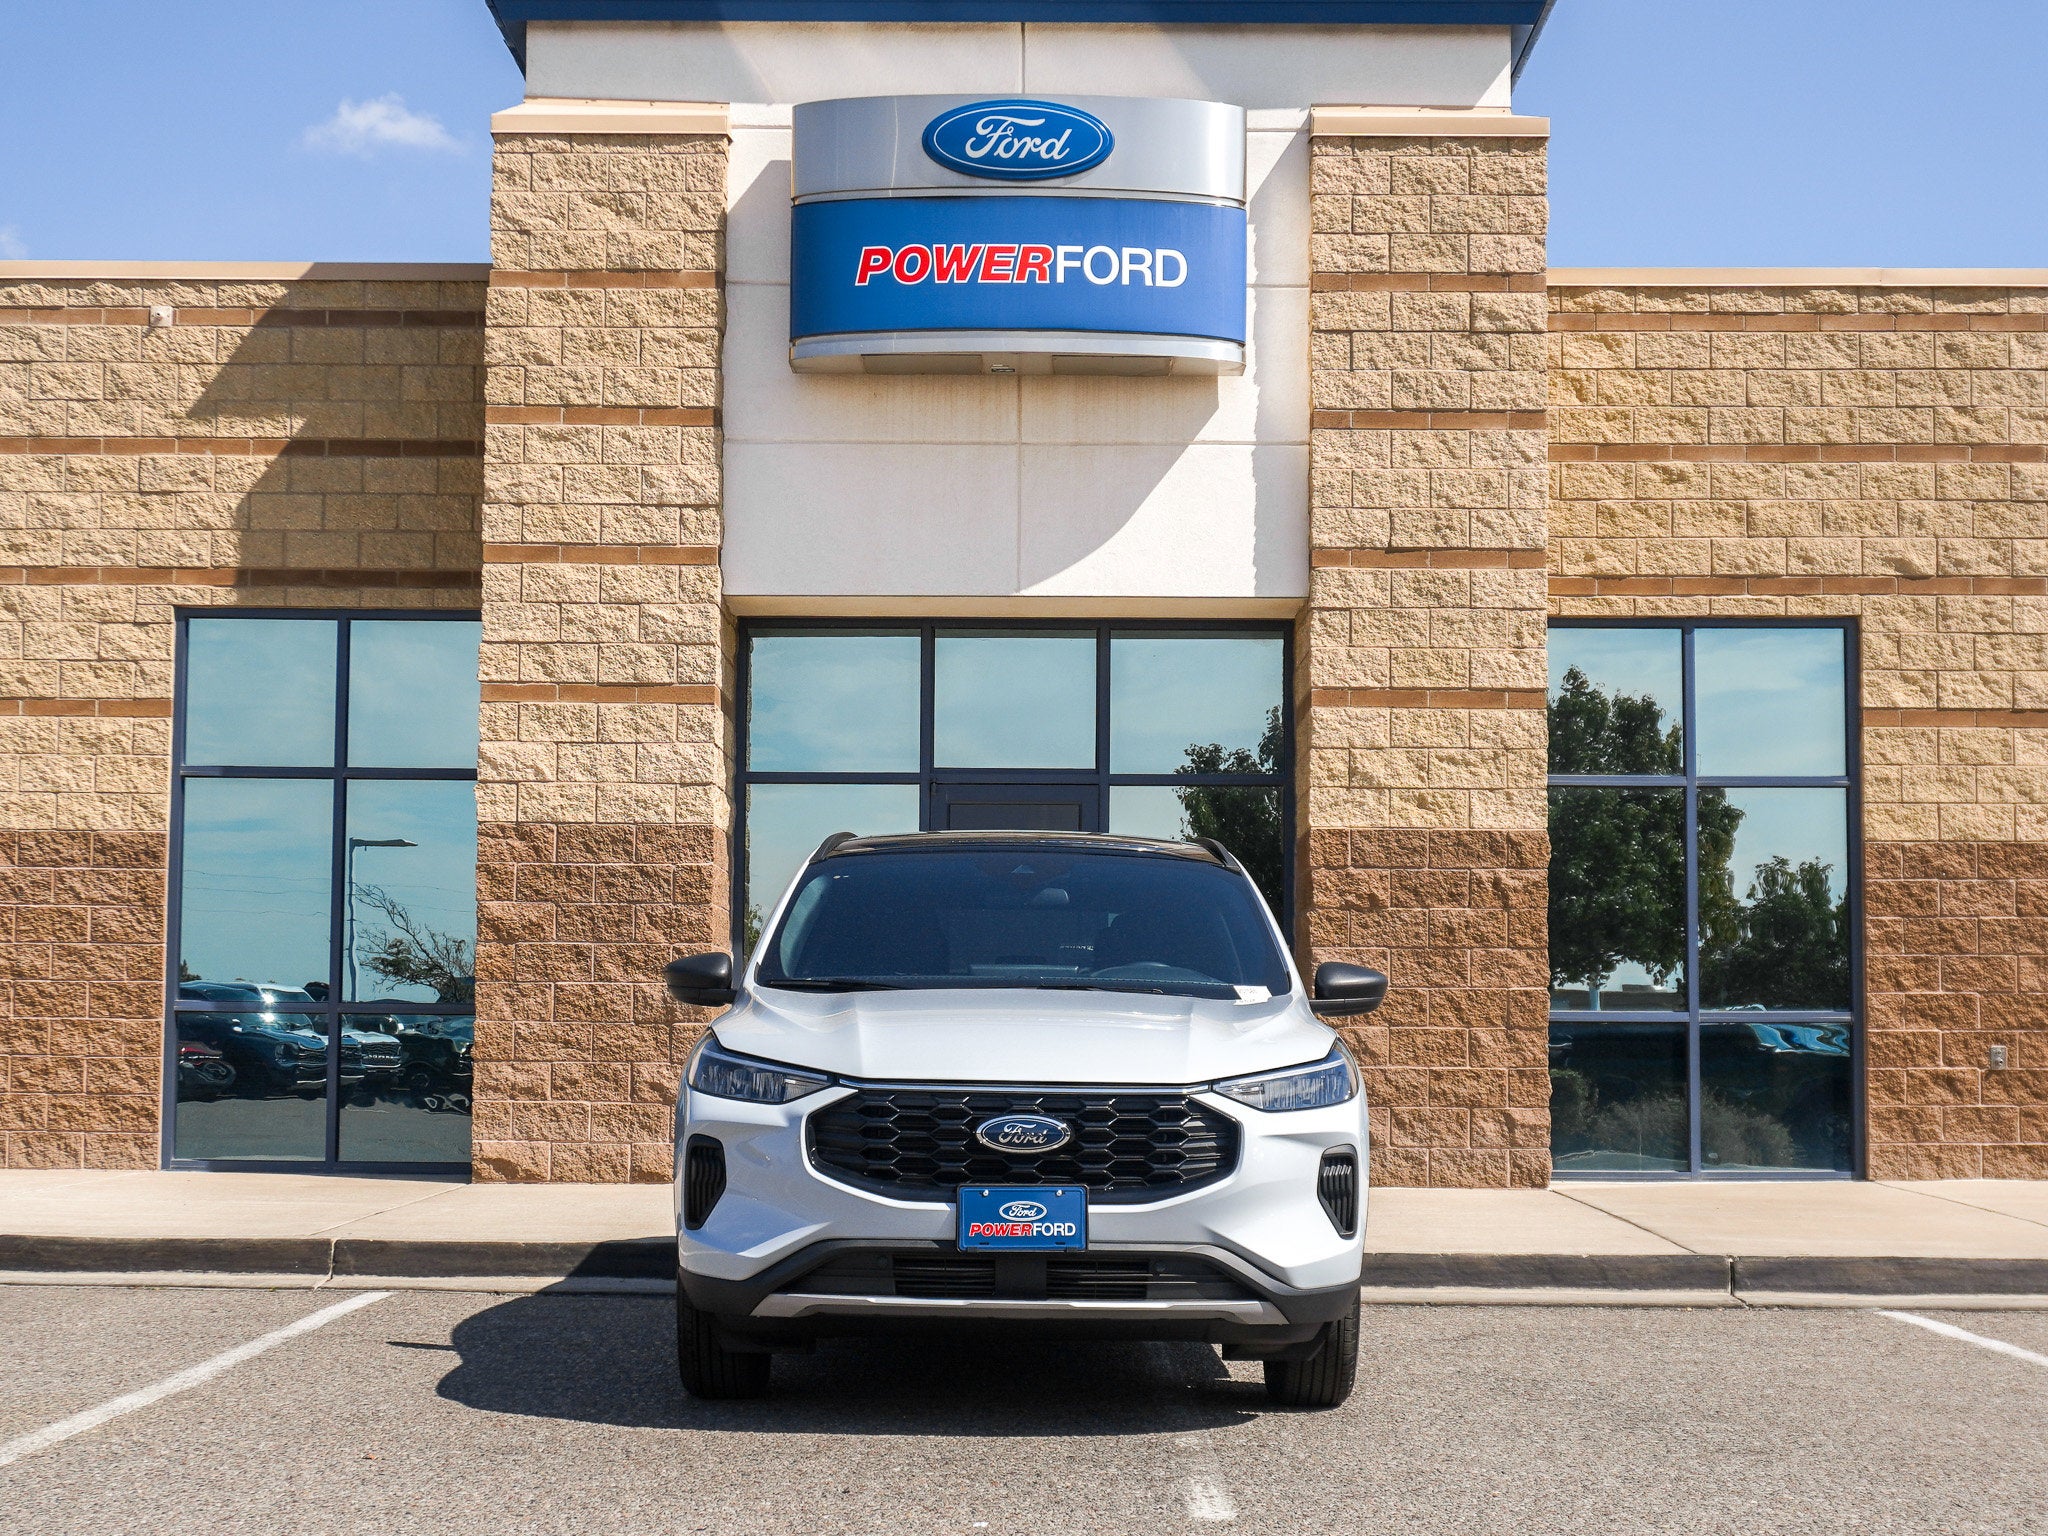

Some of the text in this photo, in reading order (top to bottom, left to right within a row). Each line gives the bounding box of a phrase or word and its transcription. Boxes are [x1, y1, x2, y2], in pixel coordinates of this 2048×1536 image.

[965, 115, 1073, 160] Ford
[998, 1122, 1048, 1144] Ford
[1009, 1205, 1037, 1217] Ford
